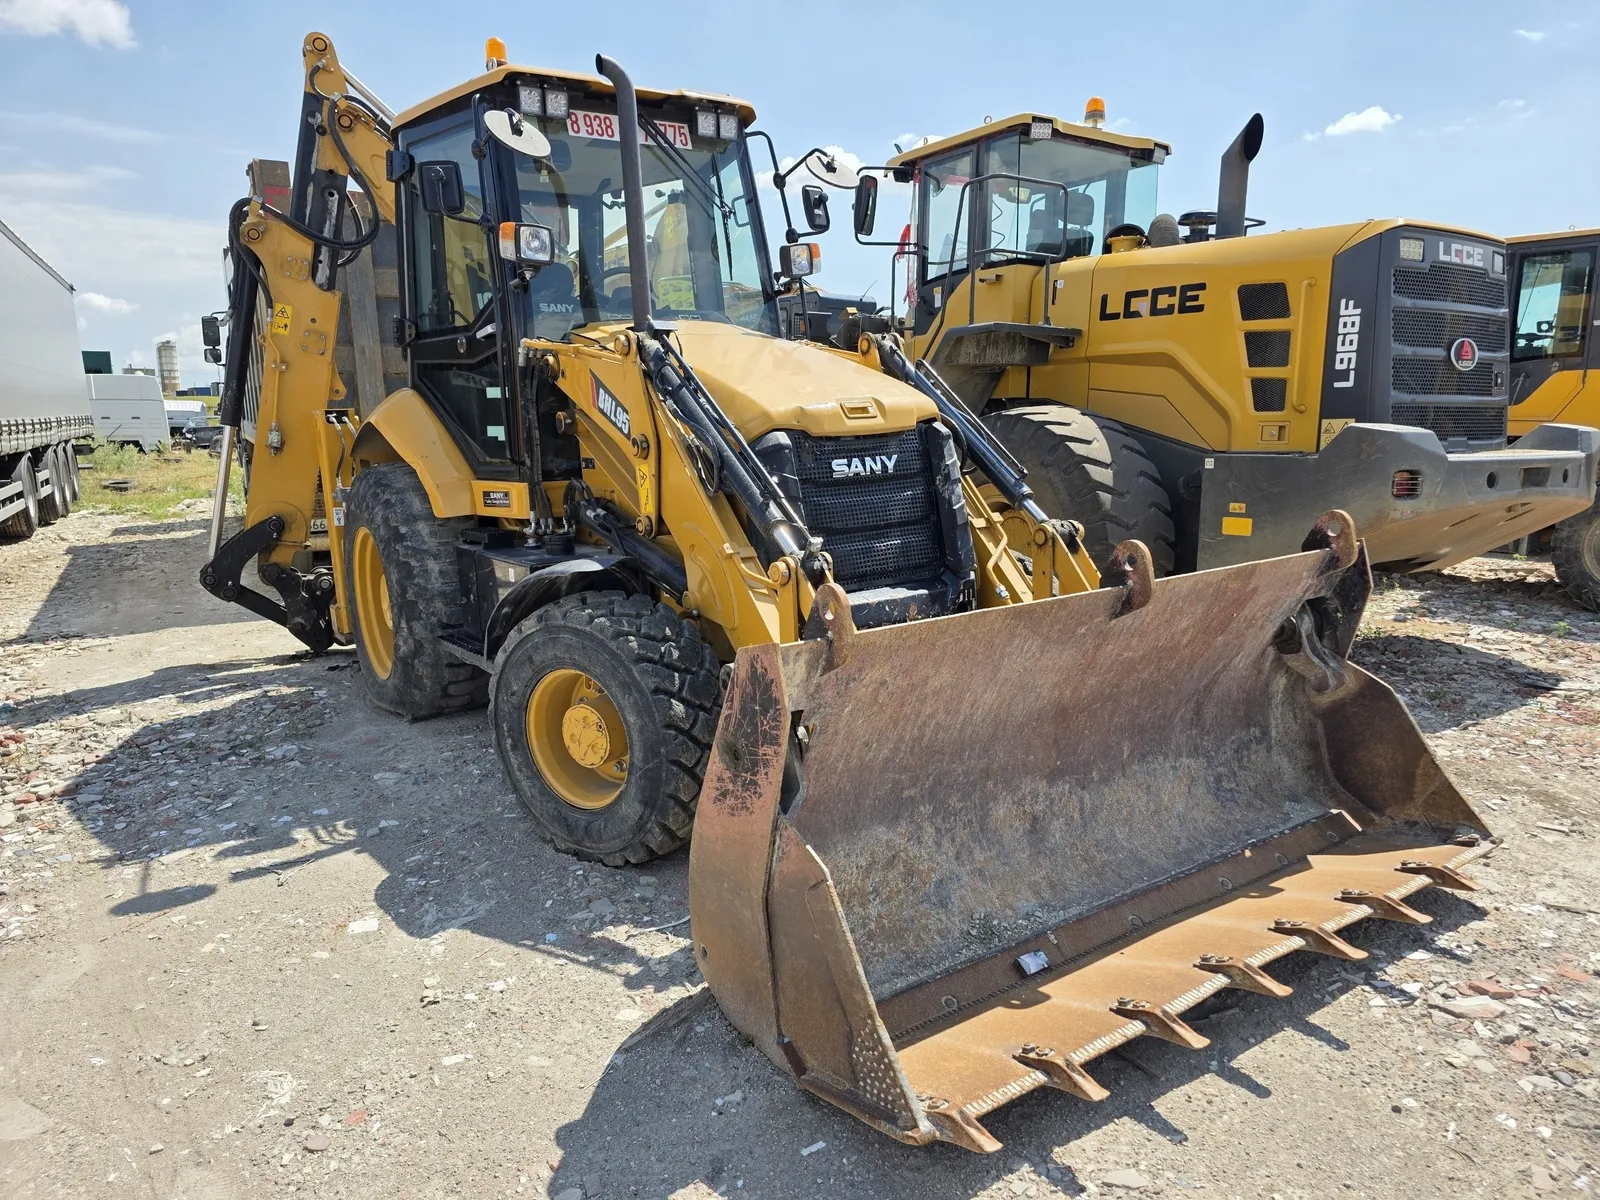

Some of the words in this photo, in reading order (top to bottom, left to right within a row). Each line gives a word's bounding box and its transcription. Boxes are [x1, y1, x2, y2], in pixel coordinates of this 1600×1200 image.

[569, 111, 580, 134] 8
[583, 113, 615, 139] 938
[539, 302, 575, 313] SANY
[1333, 298, 1362, 388] L968F
[598, 387, 630, 435] BHL95
[831, 454, 898, 478] SANY
